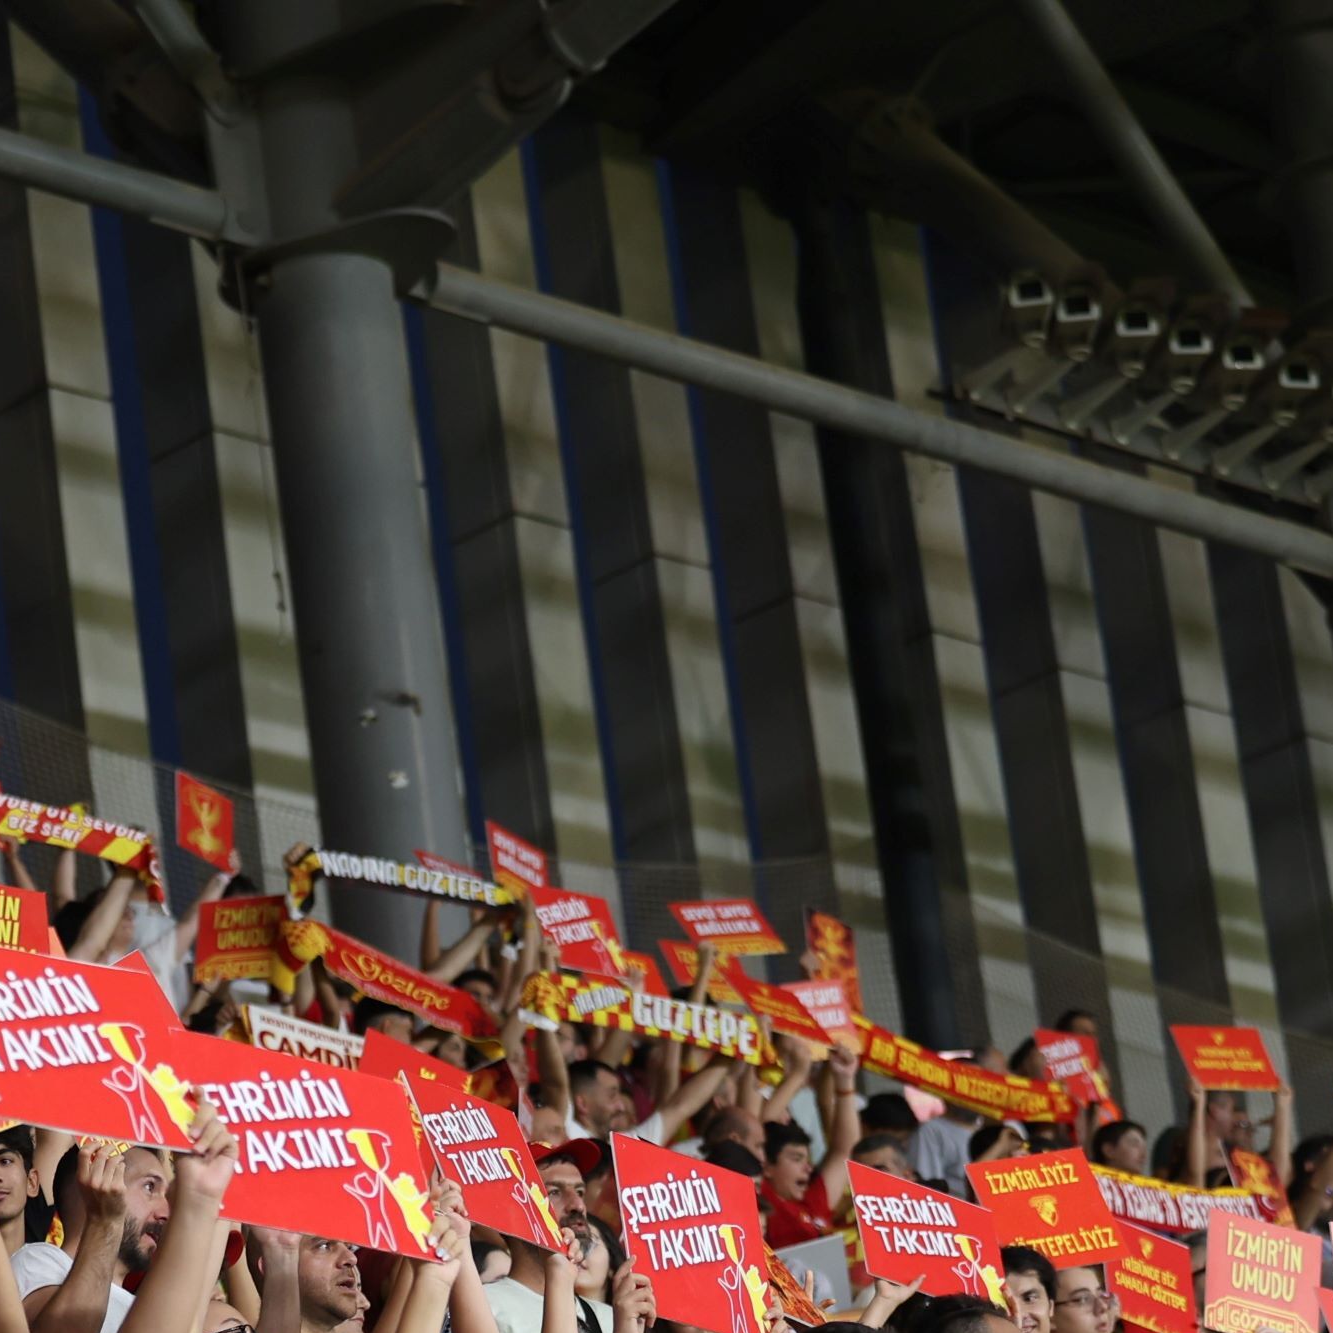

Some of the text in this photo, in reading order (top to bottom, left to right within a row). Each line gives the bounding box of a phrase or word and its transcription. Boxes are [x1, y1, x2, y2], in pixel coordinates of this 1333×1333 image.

[204, 1070, 351, 1122] EHRİMİN
[231, 1128, 356, 1174] AKIMI
[424, 1102, 497, 1154] ŞEHRİMİN
[446, 1147, 510, 1185] TAKIMI
[985, 1160, 1079, 1195] İZMİRLİYİZ
[622, 1169, 721, 1234] ŞEHRİMİN
[855, 1193, 957, 1228] ŞEHRİMİN
[640, 1224, 725, 1271] TAKIMI
[874, 1226, 960, 1258] TAKIMI
[1227, 1221, 1302, 1274] İZMİR'İN
[1232, 1261, 1295, 1302] UMUDU
